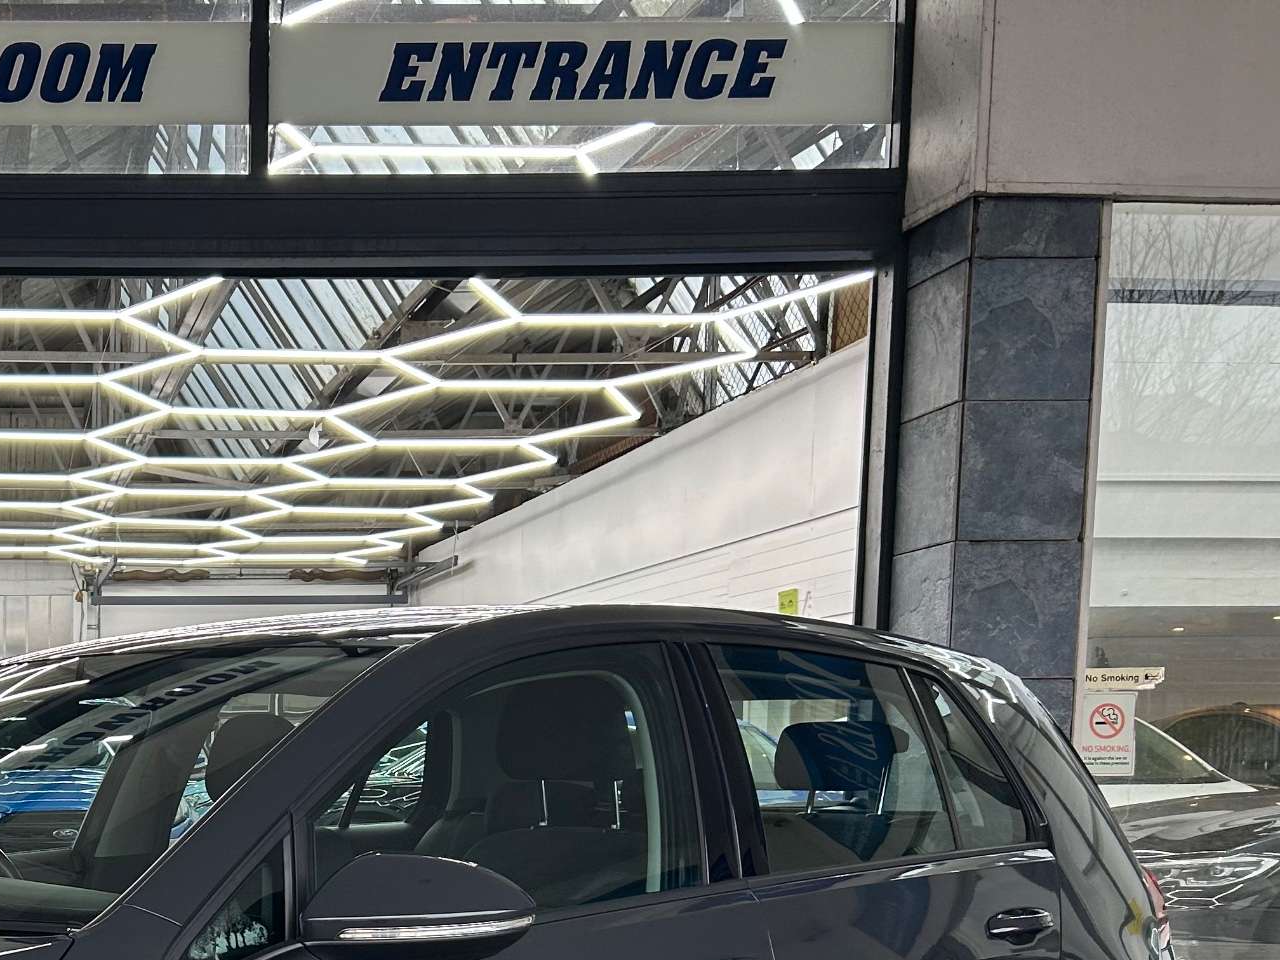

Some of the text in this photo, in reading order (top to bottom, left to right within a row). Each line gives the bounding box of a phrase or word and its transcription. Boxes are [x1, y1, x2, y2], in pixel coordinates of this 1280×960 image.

[378, 38, 788, 102] ENTRANCE
[1085, 673, 1140, 684] No Smoking
[1082, 744, 1094, 753] NO
